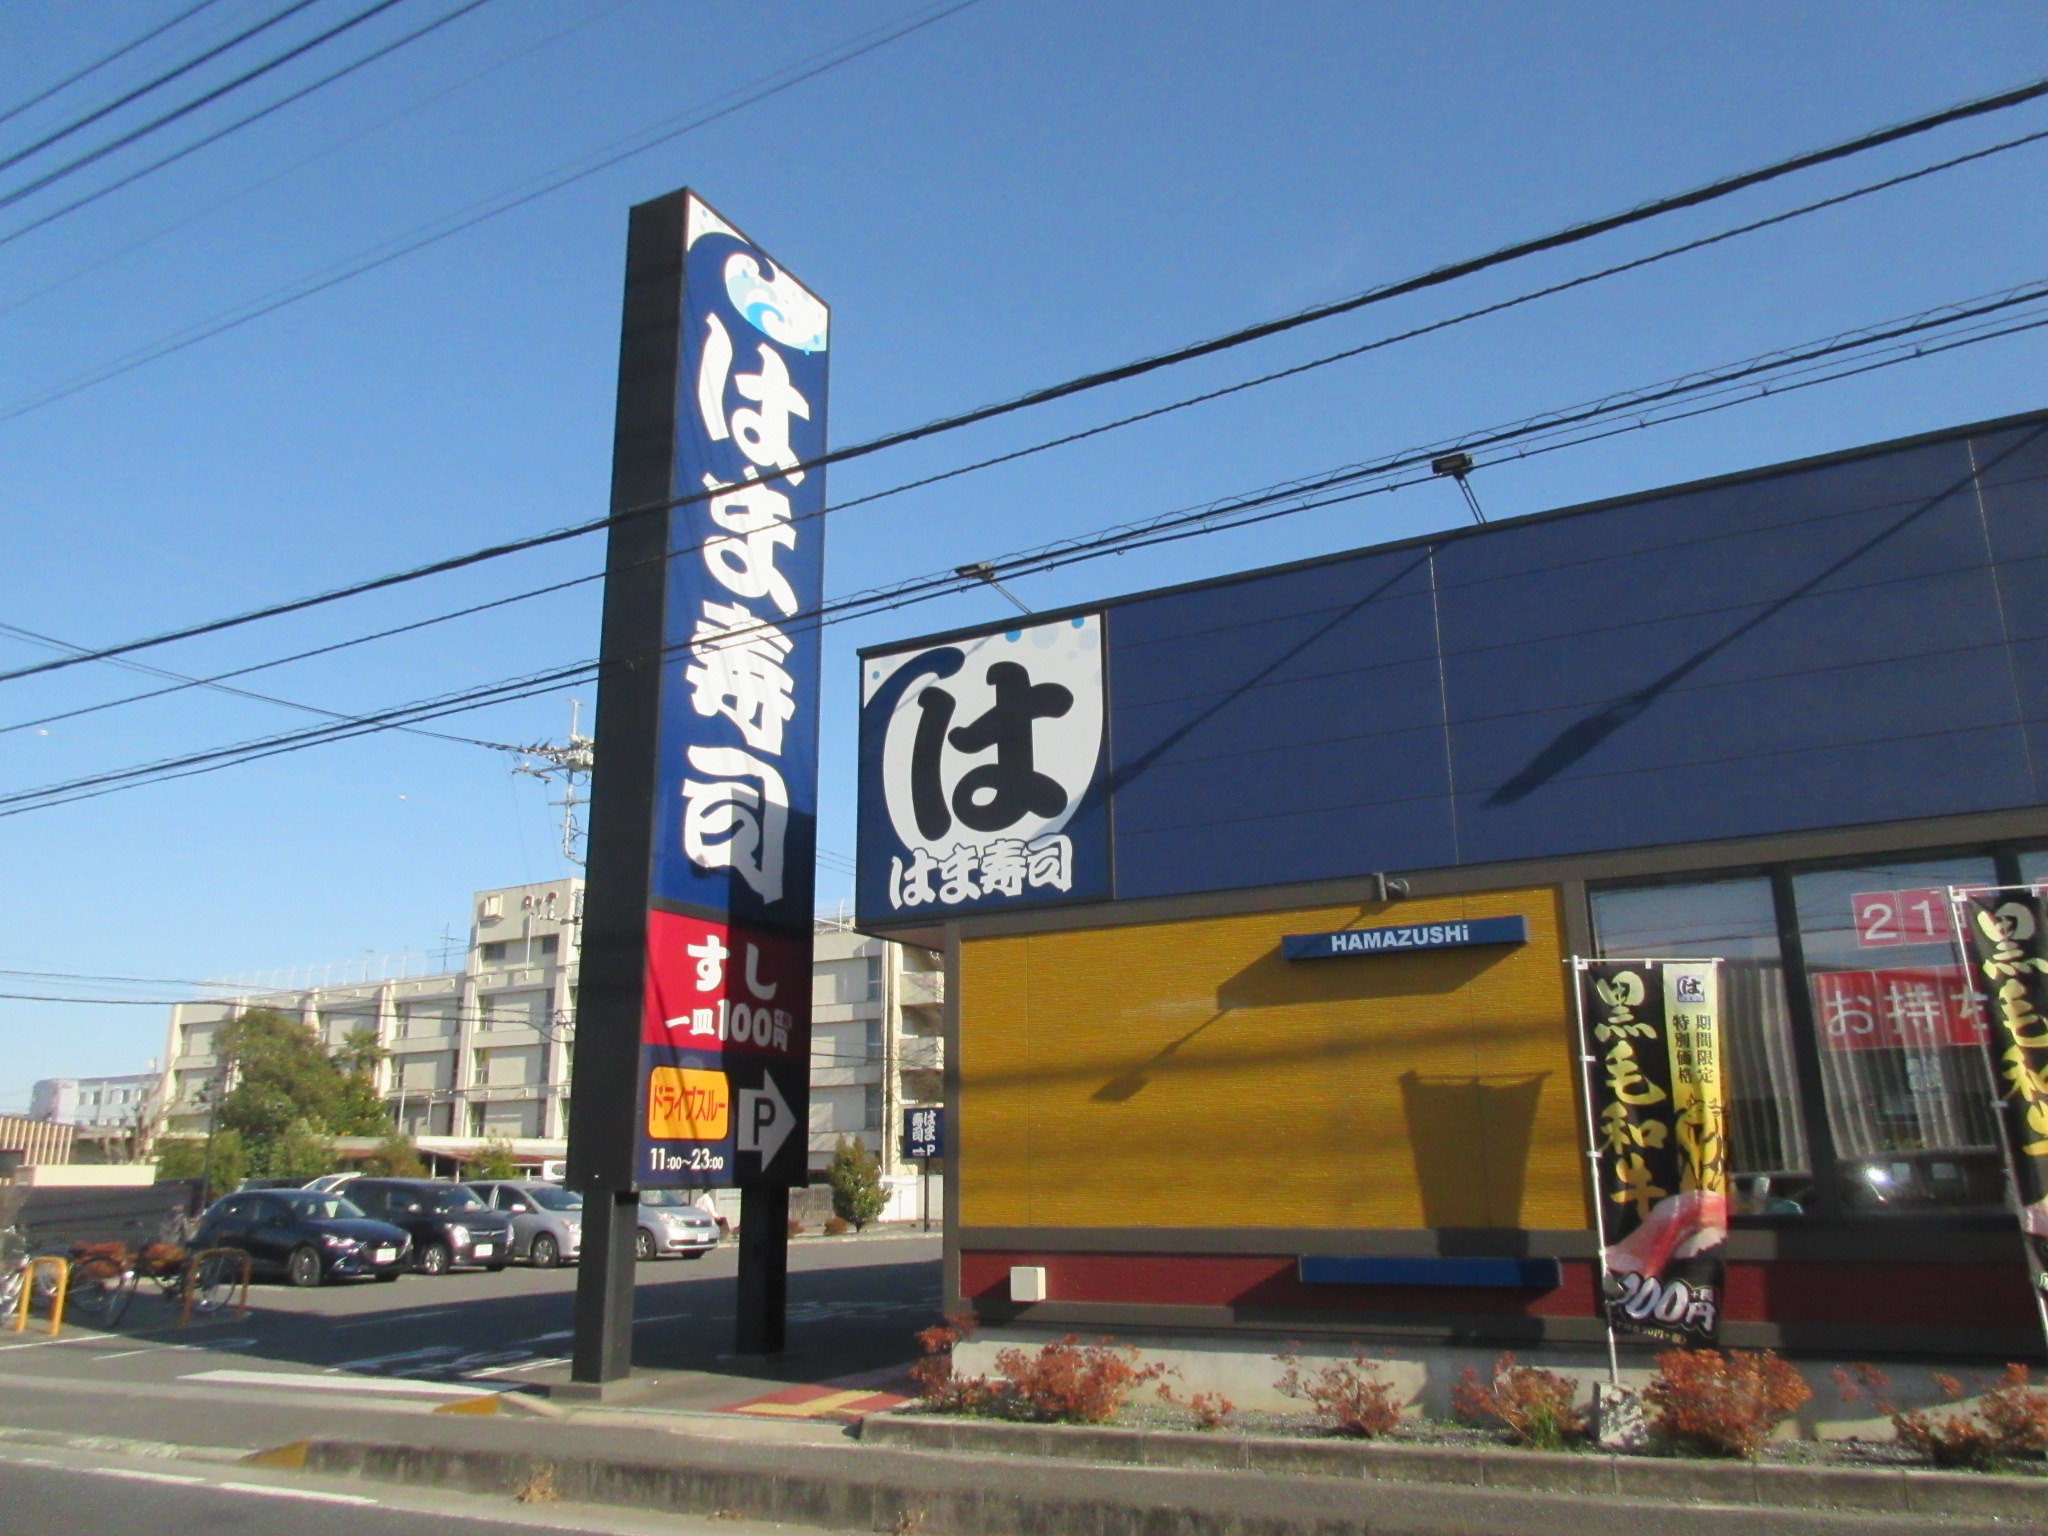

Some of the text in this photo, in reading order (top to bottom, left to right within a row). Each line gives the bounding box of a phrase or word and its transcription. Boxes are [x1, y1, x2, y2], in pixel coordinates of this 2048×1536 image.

[682, 313, 810, 905] はま寿司
[911, 661, 1074, 841] は
[889, 832, 1073, 910] はま寿司
[1862, 900, 1967, 940] 21
[687, 934, 777, 1001] すし
[1672, 1014, 1693, 1084] 特別価格
[1696, 1014, 1714, 1084] 期間限定
[652, 1085, 726, 1122] ドライブスルー
[754, 1098, 776, 1146] P
[1594, 970, 1668, 1221] 黒毛和牛
[927, 1144, 936, 1156] P
